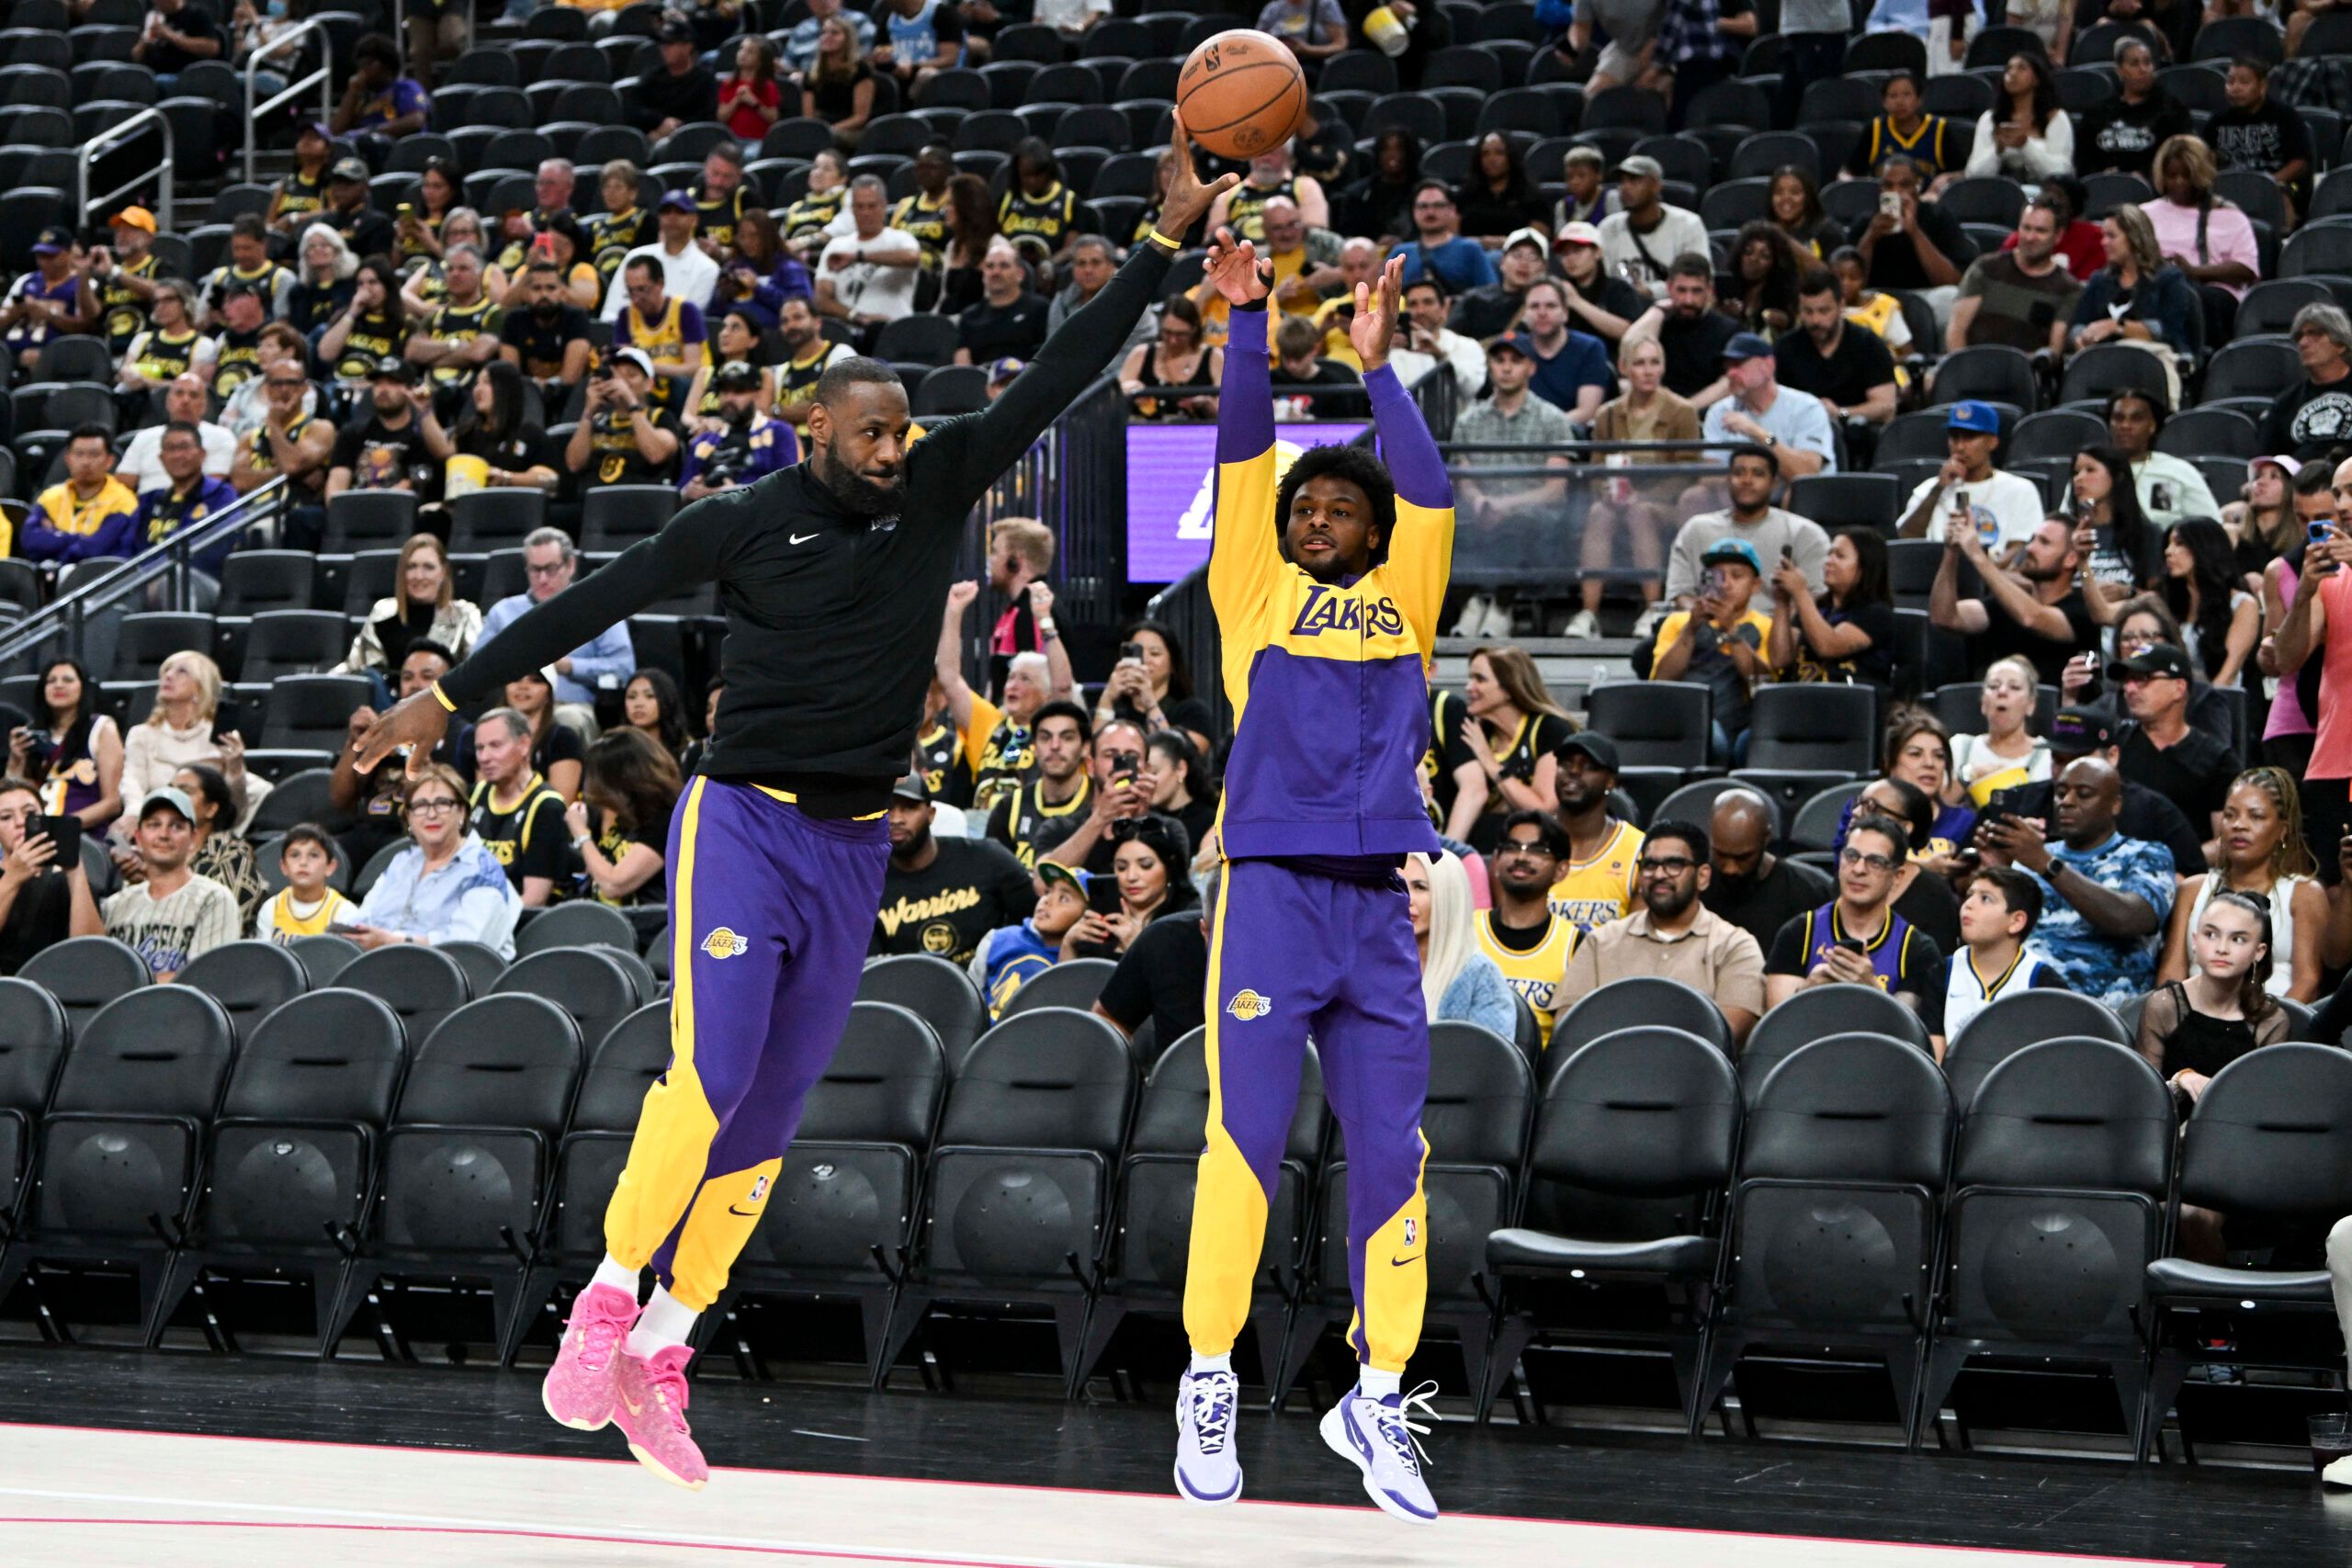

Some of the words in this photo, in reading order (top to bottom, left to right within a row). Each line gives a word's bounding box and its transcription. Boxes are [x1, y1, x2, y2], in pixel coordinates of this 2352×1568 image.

[878, 886, 981, 937] Warriors
[1547, 900, 1620, 924] AKERS
[701, 933, 749, 954] LAKERS
[1227, 997, 1272, 1016] LAKERS
